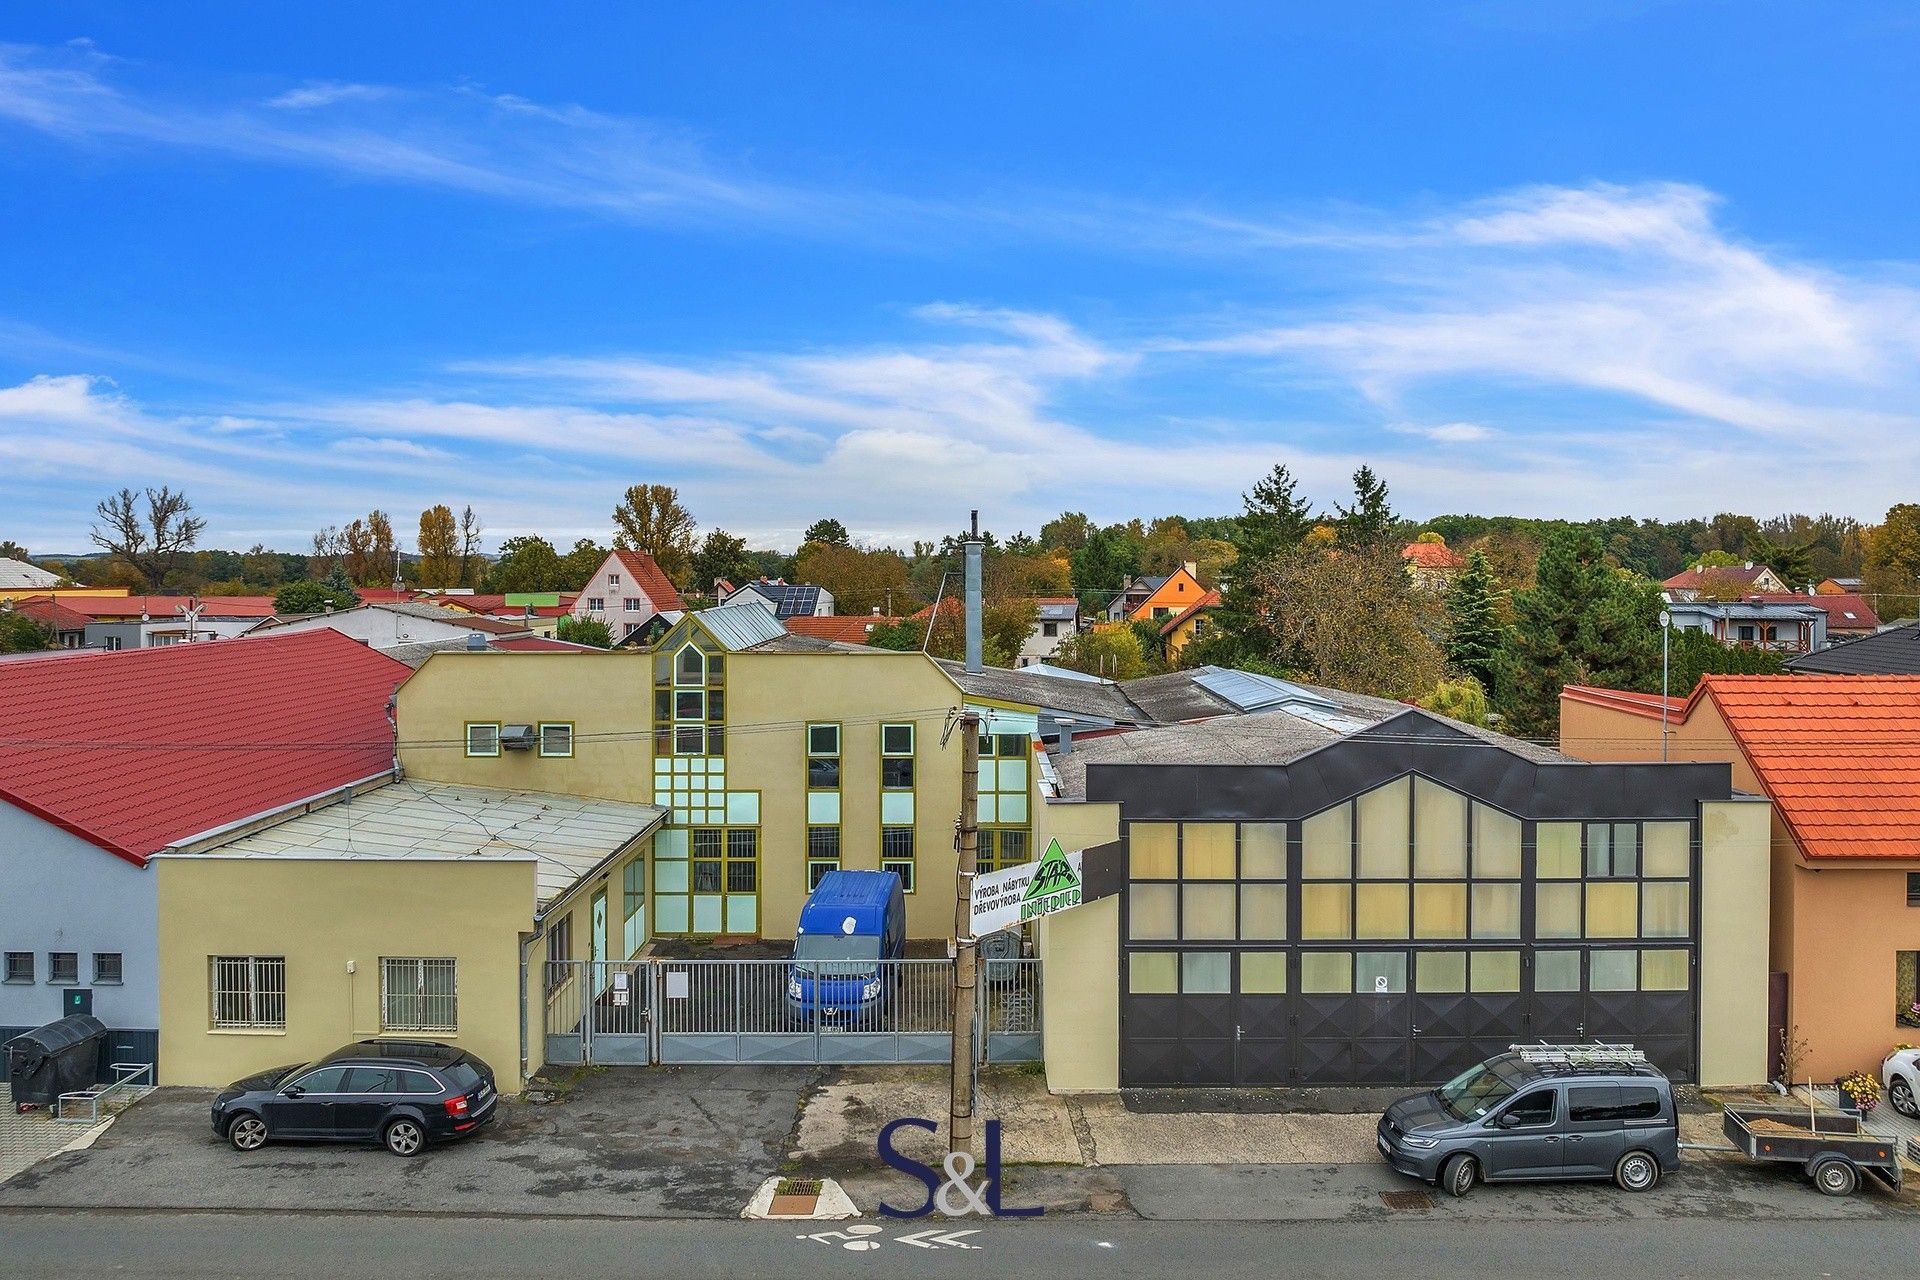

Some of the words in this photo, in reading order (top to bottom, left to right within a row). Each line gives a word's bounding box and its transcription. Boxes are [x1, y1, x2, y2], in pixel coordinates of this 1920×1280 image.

[974, 884, 1000, 900] VÝROBA
[1002, 875, 1030, 893] NÁBYTKU
[973, 893, 1021, 915] DŘEVOVÝROBA
